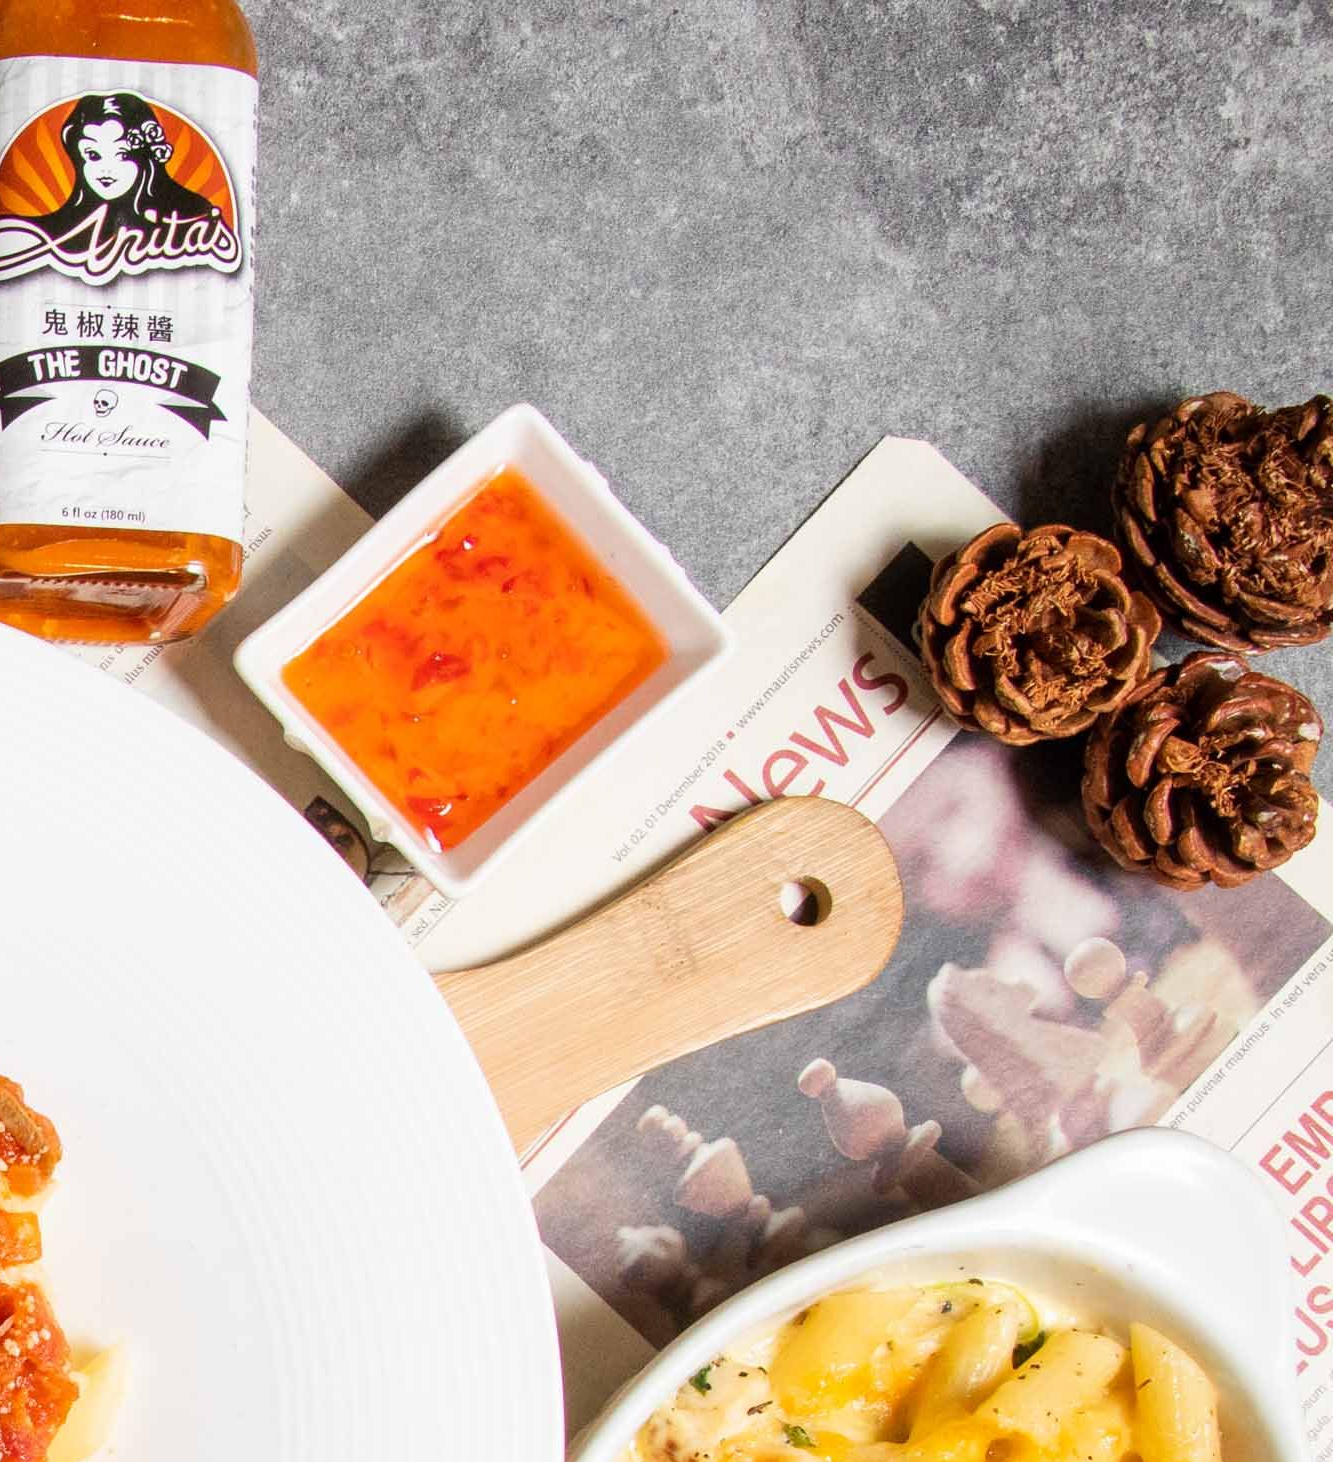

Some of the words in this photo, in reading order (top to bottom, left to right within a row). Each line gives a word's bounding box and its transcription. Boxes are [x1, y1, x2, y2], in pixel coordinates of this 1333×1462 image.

[42, 308, 174, 343] 鬼椒辣醬
[28, 349, 81, 381] THE
[98, 349, 189, 390] GHOST
[40, 421, 94, 444] Hot
[97, 422, 171, 449] Sauce
[61, 507, 69, 519] 6
[73, 507, 81, 519] fl
[84, 510, 98, 520] oz
[100, 508, 121, 522] (180
[125, 508, 146, 524] ml)
[246, 524, 274, 553] risus
[654, 763, 706, 817] December
[700, 739, 728, 768] 2018
[735, 612, 846, 730] www.maurisnews.com
[1185, 1066, 1227, 1112] pulvinar
[1269, 1005, 1285, 1020] In
[1280, 983, 1305, 1008] sed
[1300, 960, 1328, 987] vera
